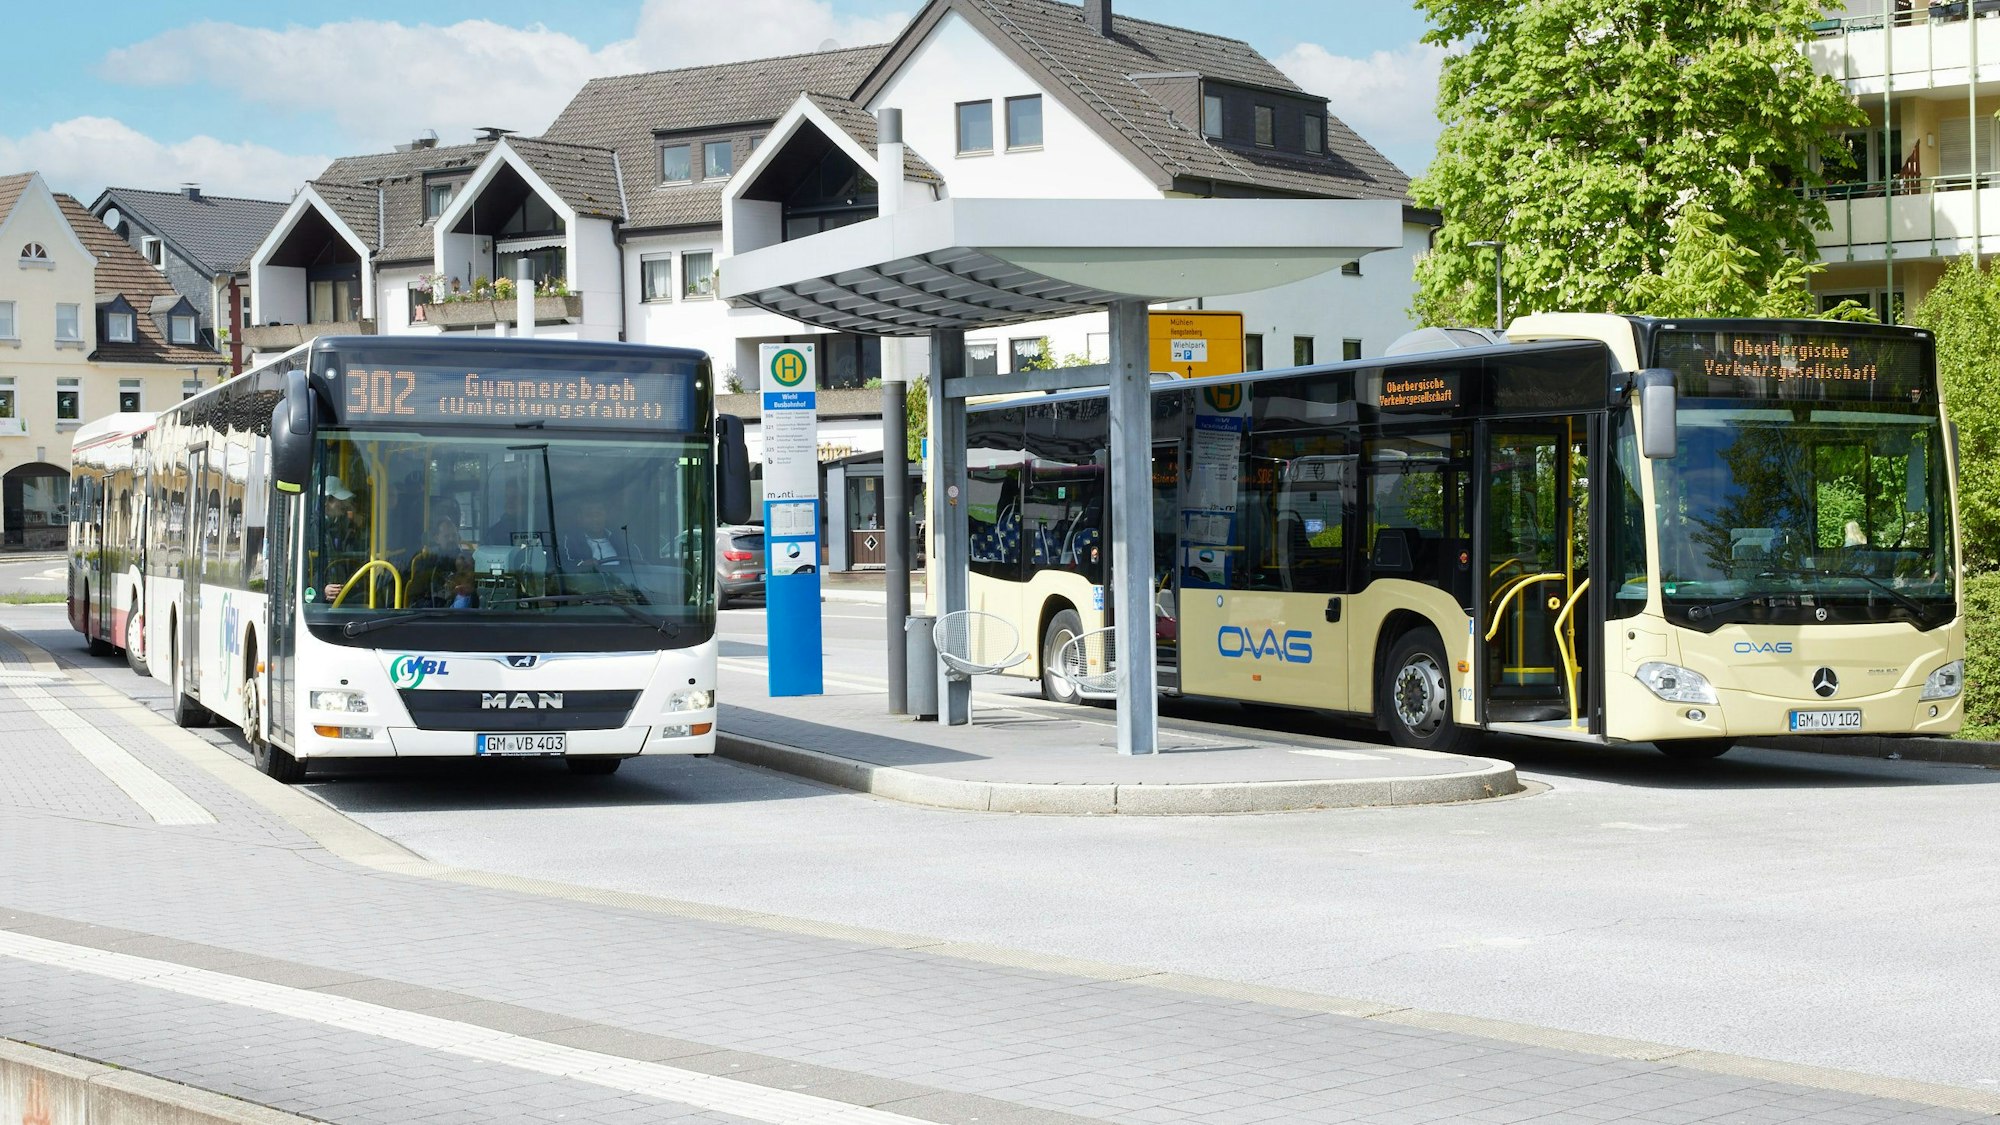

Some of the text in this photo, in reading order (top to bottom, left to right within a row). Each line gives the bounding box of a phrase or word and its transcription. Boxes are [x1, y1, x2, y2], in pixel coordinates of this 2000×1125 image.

[1170, 318, 1194, 326] Mühlen
[1170, 328, 1203, 337] Hengstenberg
[1173, 341, 1206, 350] Wiehlpark
[1733, 339, 1850, 362] Oberbergische
[781, 357, 797, 379] H
[1704, 359, 1877, 383] Verkehrsgesellschaft
[347, 369, 415, 415] 302
[465, 373, 636, 401] Gummersbach
[1386, 377, 1445, 393] Oberbergische
[1379, 389, 1452, 407] Verkehrsgesellschaft
[439, 396, 663, 419] (Umleitungsfahrt)
[1217, 625, 1313, 664] OVAG
[1733, 641, 1793, 654] OVAG
[406, 656, 450, 676] VBL
[481, 692, 564, 709] MAN
[1457, 687, 1473, 701] 102
[1798, 713, 1814, 727] GM
[1838, 712, 1860, 726] 102
[487, 737, 506, 751] GM
[515, 737, 534, 750] VB
[537, 737, 563, 750] 403
